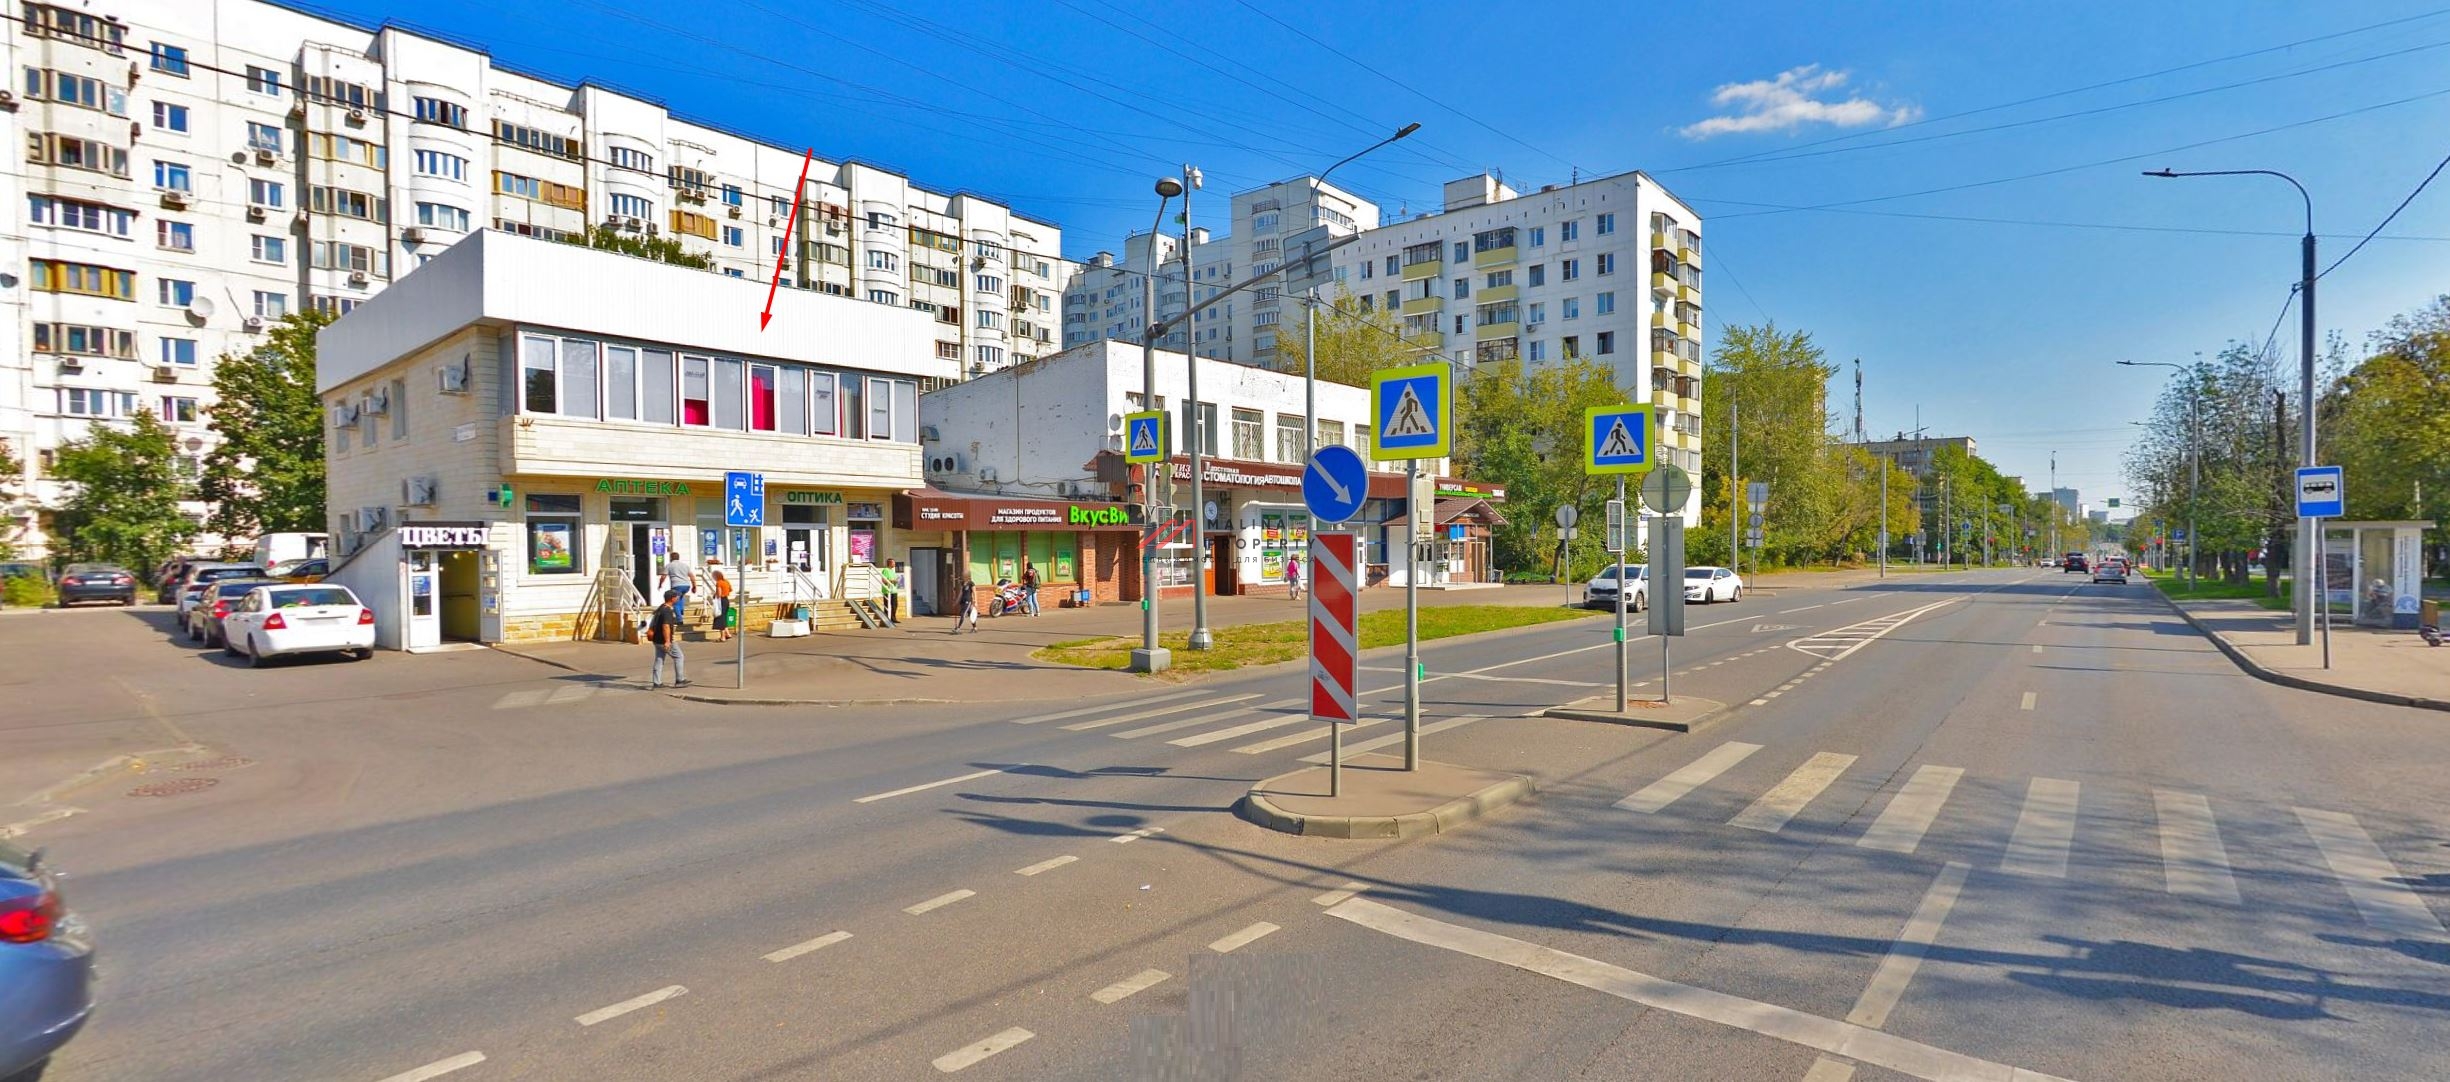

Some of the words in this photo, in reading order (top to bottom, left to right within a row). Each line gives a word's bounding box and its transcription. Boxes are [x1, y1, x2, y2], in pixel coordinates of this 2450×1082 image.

[1203, 471, 1264, 486] СТОМАТОЛОГИЯ
[1265, 474, 1302, 486] АВТОШКОЛА
[596, 479, 690, 496] АПТЕКА
[787, 491, 843, 504] ОПТИКА
[991, 516, 1004, 524] ДЛЯ
[1005, 516, 1037, 524] ЗДОРОВОГО
[1070, 505, 1129, 528] ВкусВи
[397, 526, 491, 548] ЦВЕТЫ
